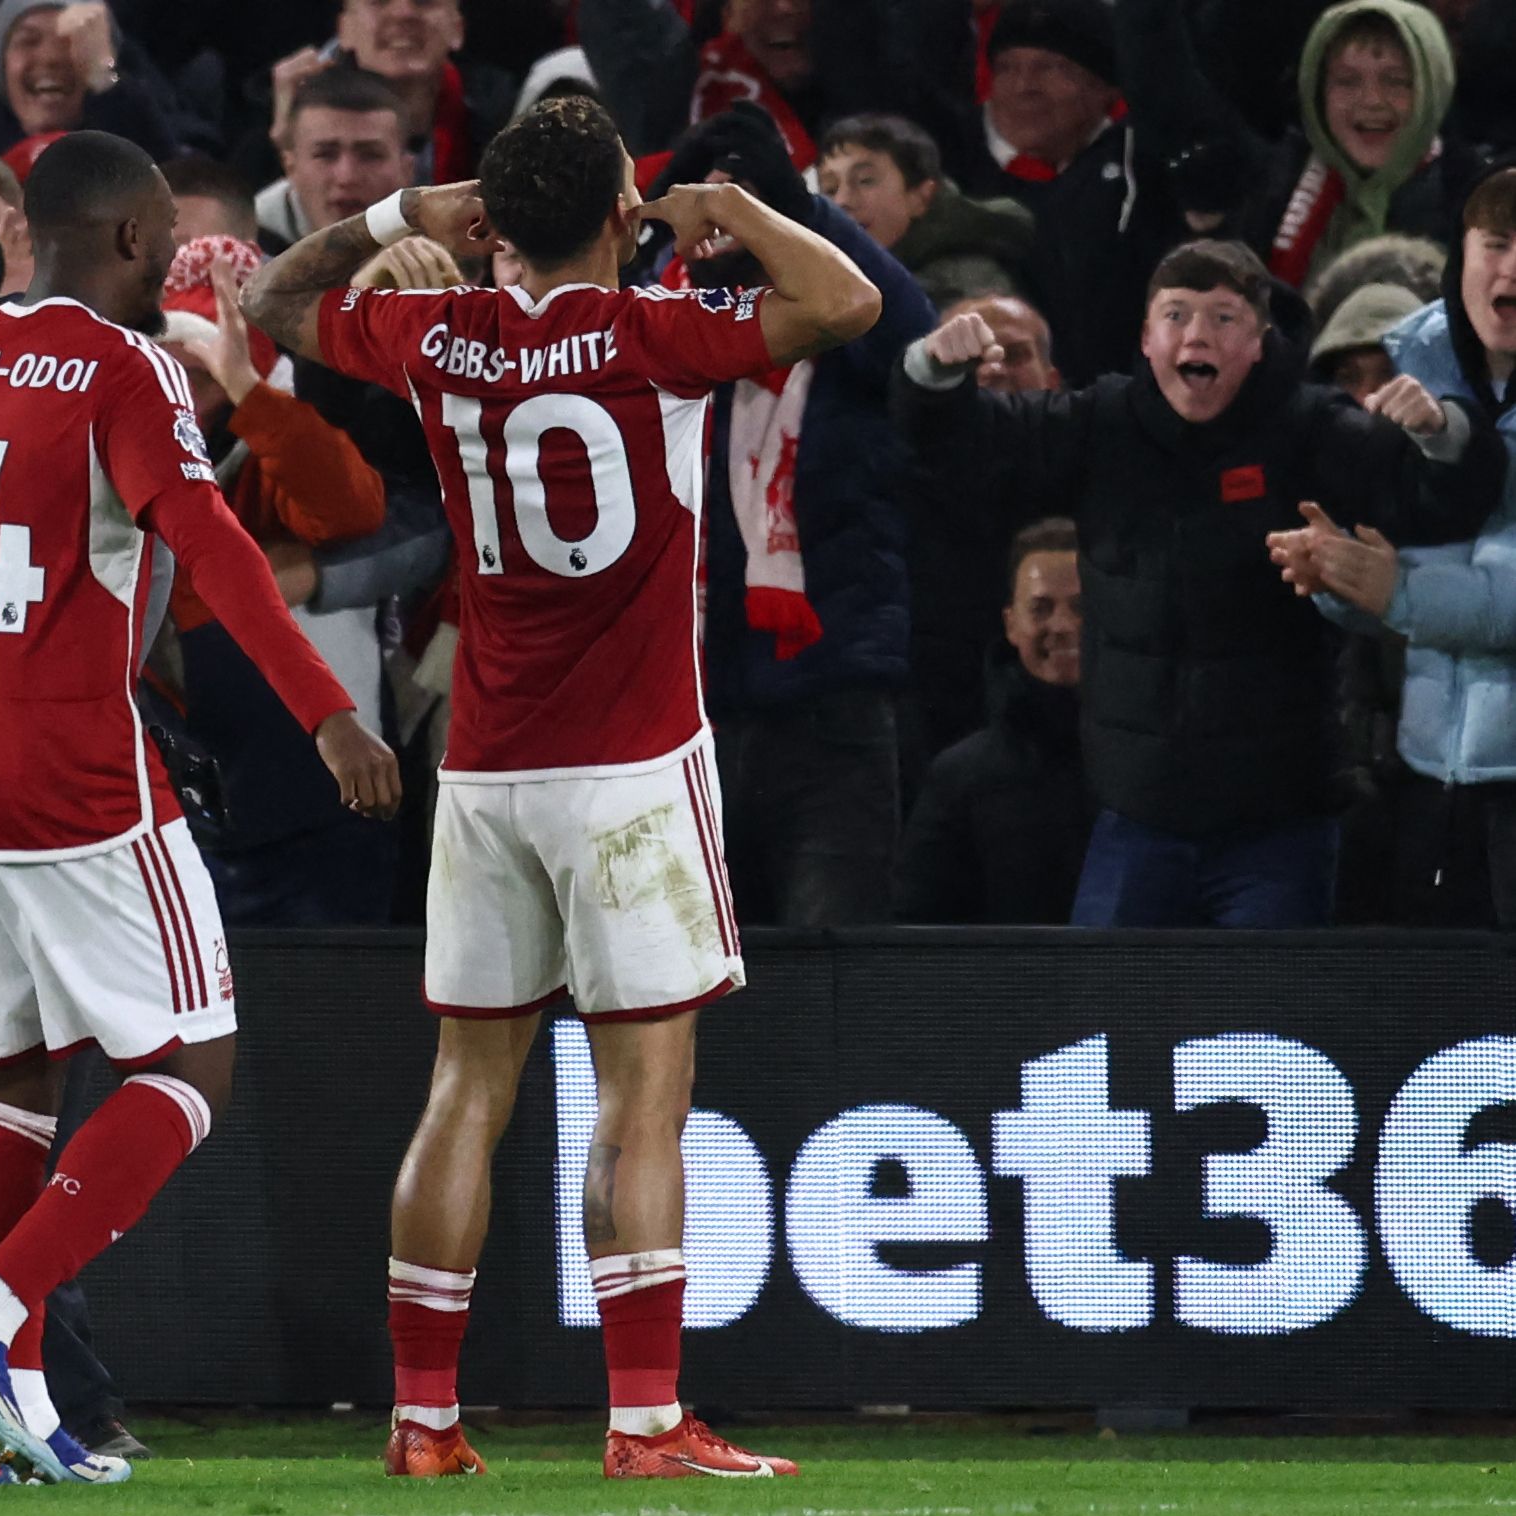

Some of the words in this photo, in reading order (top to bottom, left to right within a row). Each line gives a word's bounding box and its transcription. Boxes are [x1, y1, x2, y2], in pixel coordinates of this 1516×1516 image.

[420, 323, 618, 384] GIBBS-WHITE
[442, 392, 636, 578] 10
[47, 1172, 82, 1195] FC
